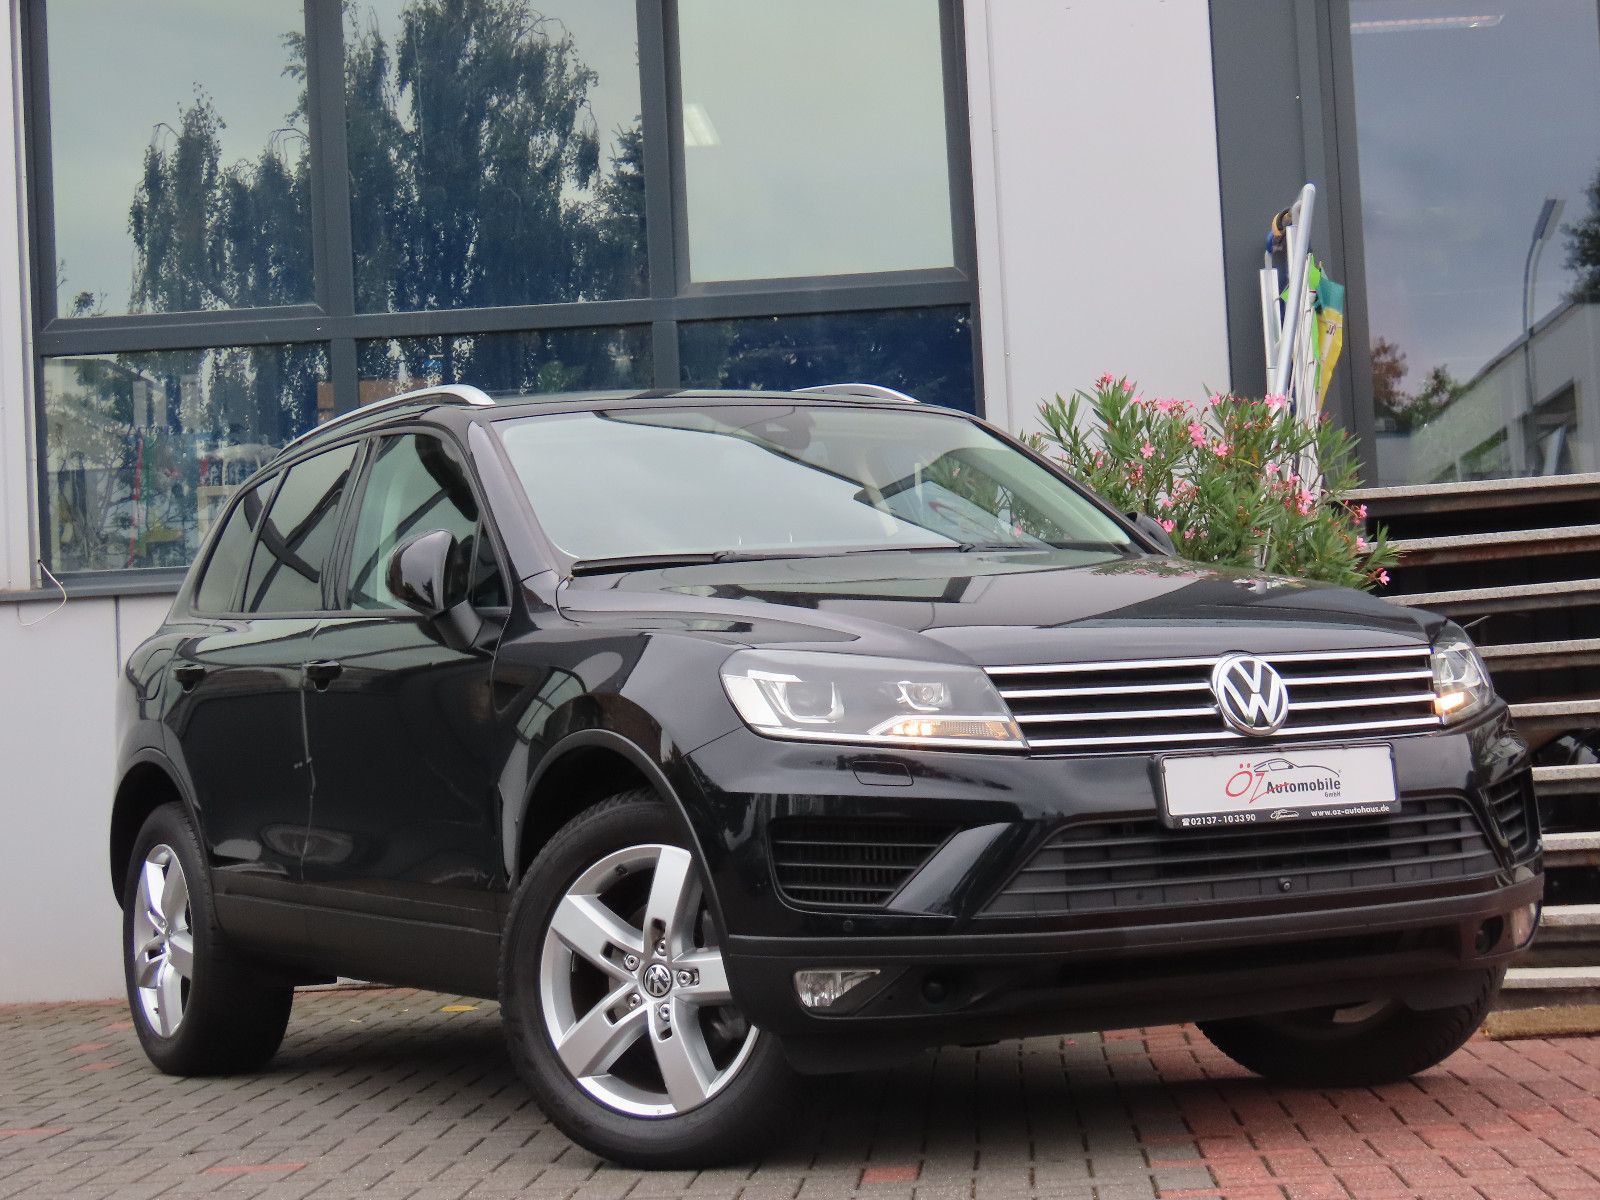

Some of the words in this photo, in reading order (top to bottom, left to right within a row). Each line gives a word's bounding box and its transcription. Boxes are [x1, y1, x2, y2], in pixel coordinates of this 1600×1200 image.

[1216, 656, 1285, 730] VW
[1266, 777, 1341, 794] Automobile
[1310, 804, 1390, 817] www.oz-autohaus.de
